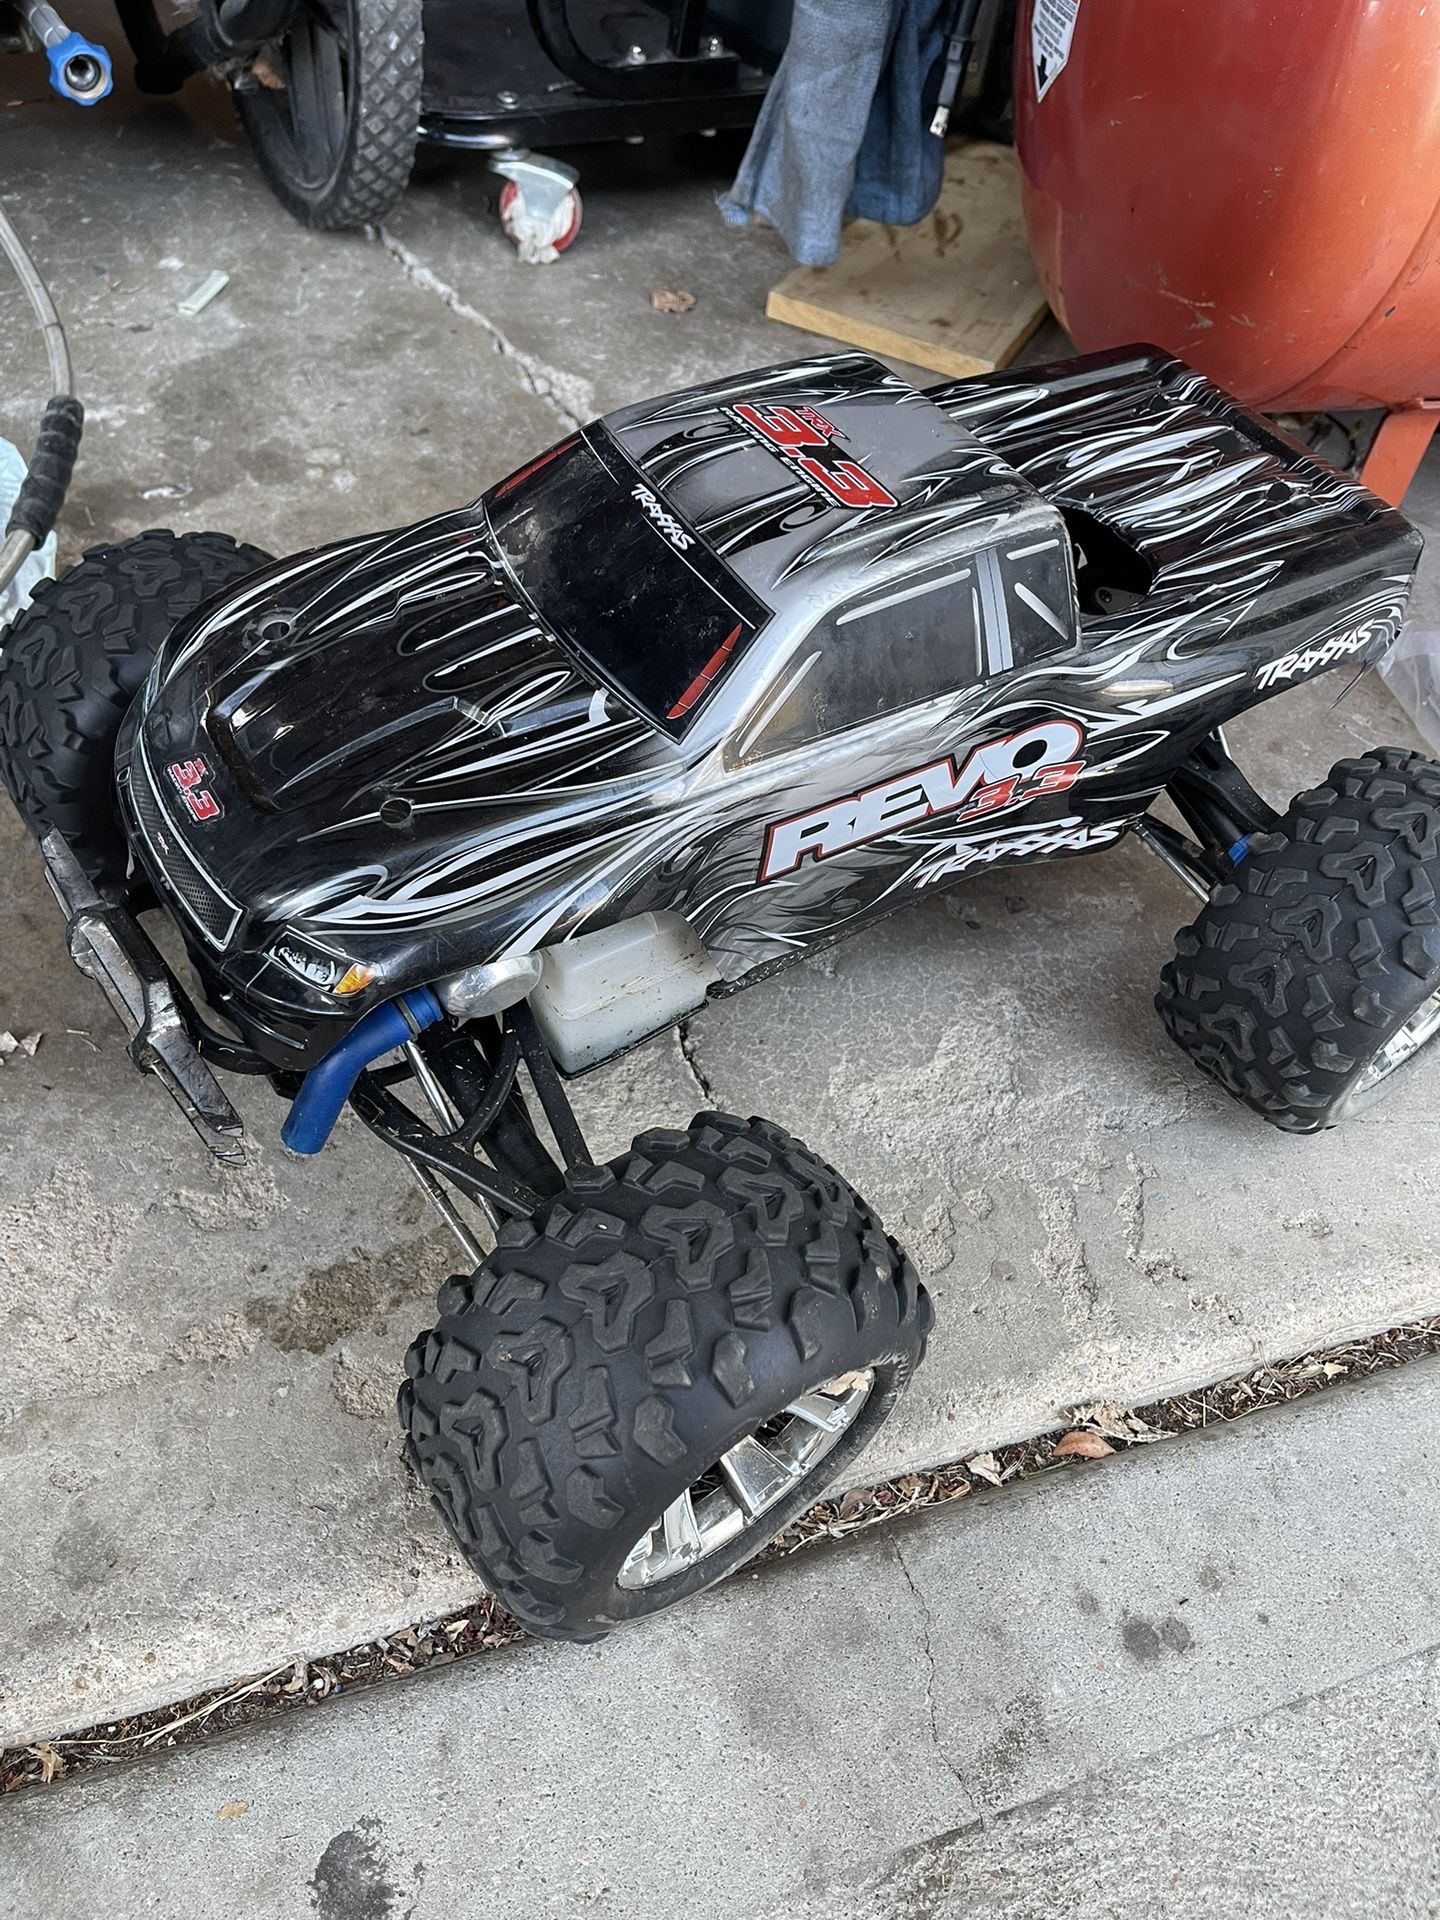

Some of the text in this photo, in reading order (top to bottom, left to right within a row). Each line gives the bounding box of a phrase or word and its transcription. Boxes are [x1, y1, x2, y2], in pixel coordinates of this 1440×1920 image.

[720, 407, 842, 507] RACING ENGINE
[733, 404, 899, 509] 3.3
[795, 406, 849, 441] TRX
[631, 483, 696, 550] TRAXXAS
[1253, 618, 1375, 690] TRAXXAS
[172, 761, 220, 820] 3.3
[760, 719, 1084, 881] REVO
[957, 760, 1087, 822] 3.3
[909, 819, 1128, 889] TRAXXAS
